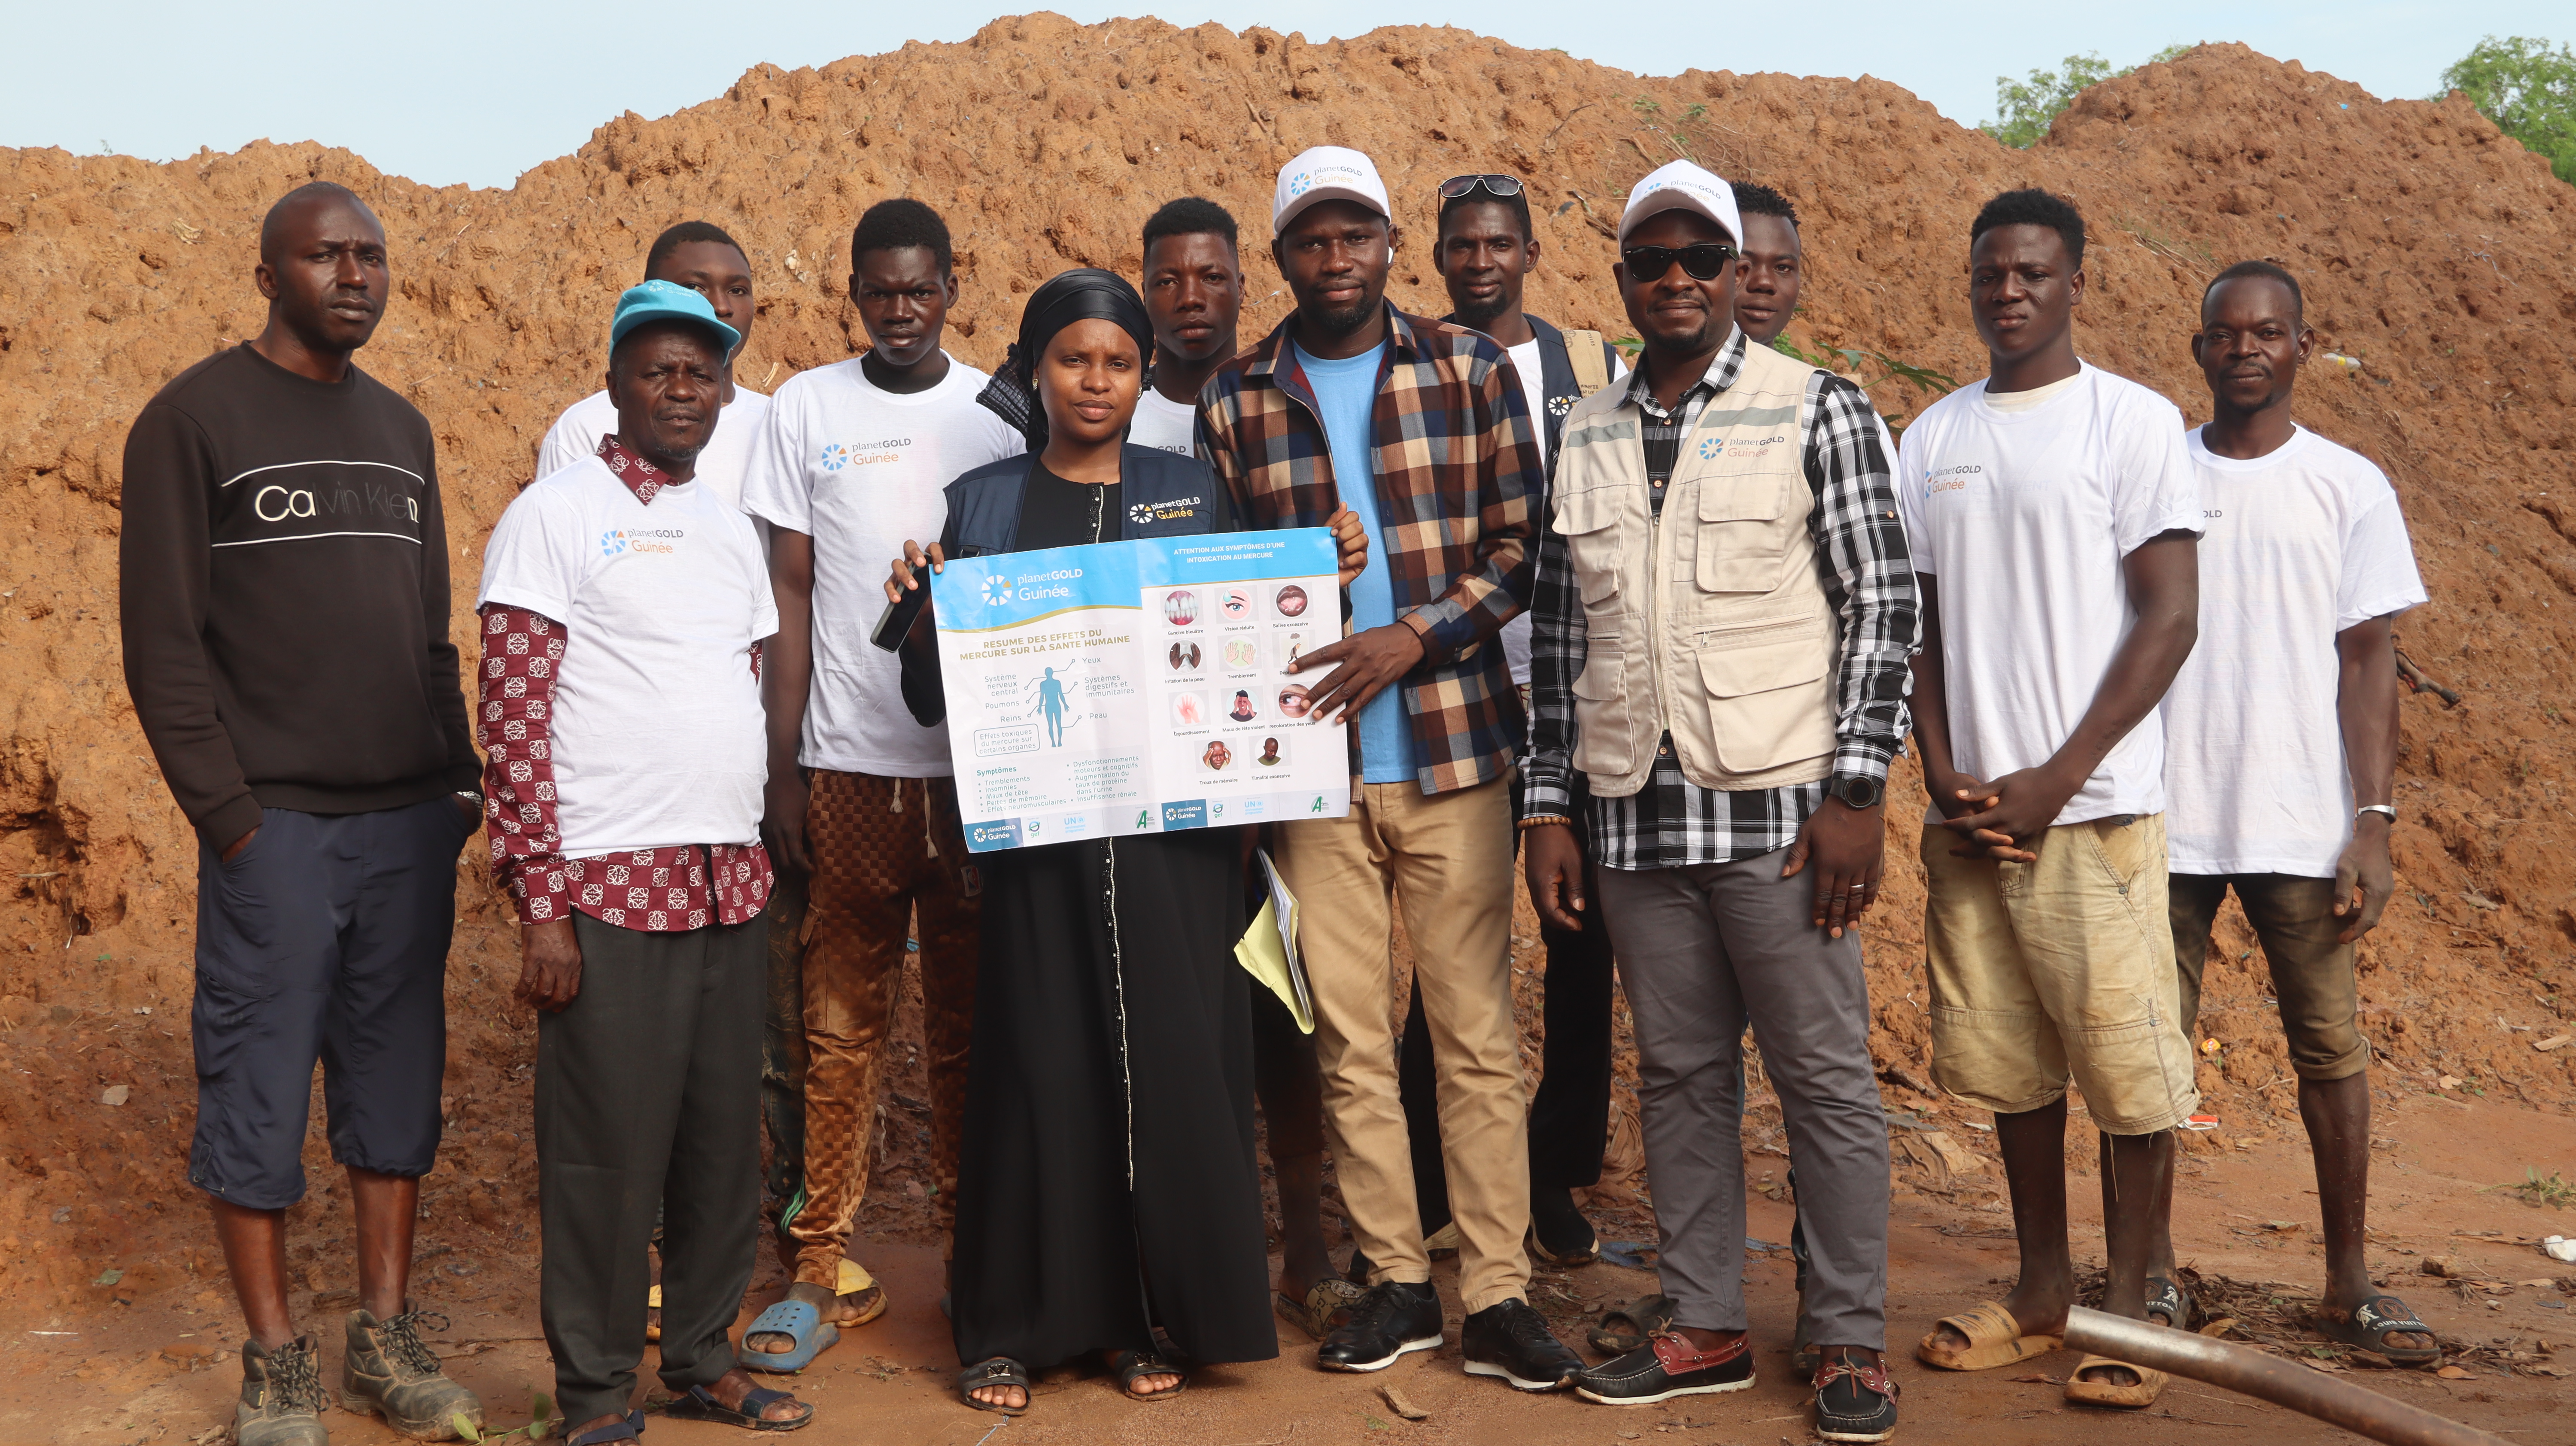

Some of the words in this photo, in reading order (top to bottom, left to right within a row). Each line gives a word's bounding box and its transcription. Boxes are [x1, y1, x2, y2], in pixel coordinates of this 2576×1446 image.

[1314, 167, 1362, 176] planetGOLD
[1315, 174, 1353, 185] Guinée
[1671, 179, 1721, 199] planetGOLD
[852, 438, 911, 452] planetGOLD
[1730, 436, 1784, 446] planetGOLD
[1728, 448, 1768, 457] Guinée
[854, 452, 899, 465] Guinée
[1934, 466, 1981, 479] planetGOLD
[1933, 478, 1964, 493] Guinée
[255, 481, 361, 521] Calvin
[1151, 497, 1200, 510] planetGOLD
[1156, 507, 1193, 519] Guinée
[628, 529, 683, 538] planetGOLD
[632, 540, 673, 553] Guinée
[1226, 543, 1265, 551] SYMPTÔMES
[1018, 568, 1083, 586] planetGOLD
[1018, 584, 1069, 601] Guinée
[984, 637, 1024, 649] RESUME
[1028, 635, 1047, 644] DES
[1051, 631, 1085, 641] EFFETS
[960, 650, 1007, 661] MERCURE
[1011, 647, 1030, 655] SUR
[1049, 641, 1081, 651] SANTE
[1084, 635, 1130, 647] HUMAINE
[985, 674, 1016, 684] Système
[1085, 675, 1120, 684] Systèmes
[987, 681, 1017, 690] nerveux
[1085, 682, 1118, 691] digestifs
[1086, 688, 1134, 698] immunitaires
[985, 701, 1019, 709] Poumons
[1002, 729, 1032, 738] toxiques
[1008, 743, 1036, 752] organes
[1073, 756, 1139, 768] Dysfonctionnements
[1110, 762, 1138, 772] cognitifs
[977, 766, 1017, 777] Symptômes
[985, 776, 1030, 786] Tremblements
[1075, 772, 1119, 782] Augmentation
[1102, 778, 1127, 786] protéine
[1018, 794, 1047, 802] mémoire
[1077, 793, 1115, 802] Insuffisance
[1009, 799, 1066, 810] neuromusculaires
[987, 825, 1016, 833] planetGOLD
[988, 832, 1010, 840] Guinée
[2372, 1320, 2397, 1331] LOUIS
